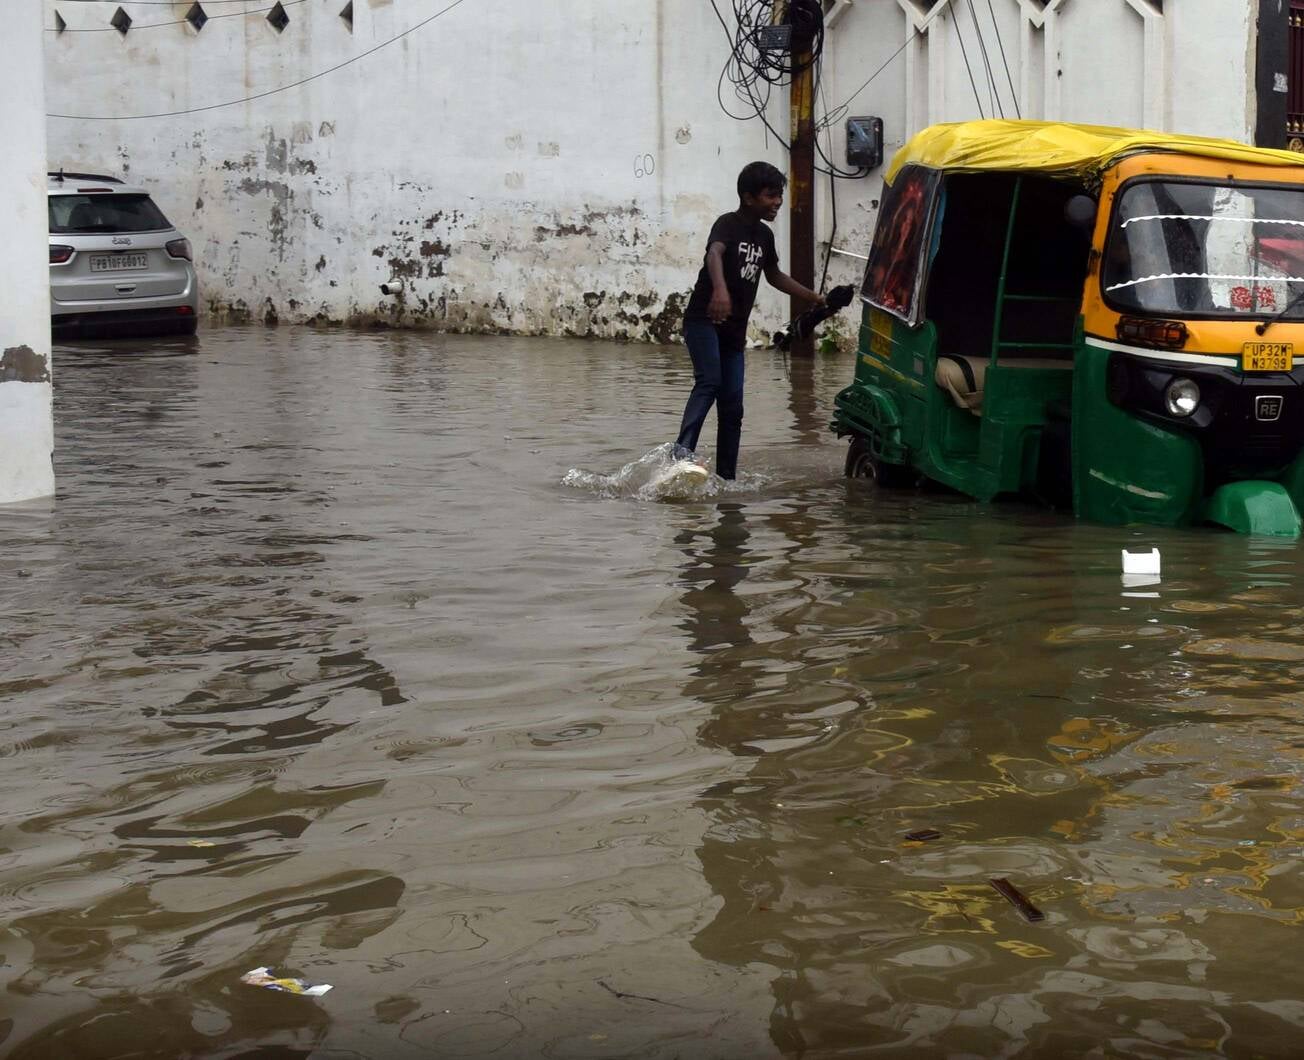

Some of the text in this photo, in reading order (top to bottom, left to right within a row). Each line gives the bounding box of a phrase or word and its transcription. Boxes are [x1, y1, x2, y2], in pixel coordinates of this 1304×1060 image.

[1252, 344, 1287, 356] UP32M
[1252, 357, 1287, 369] N3799
[1260, 404, 1278, 415] RE
